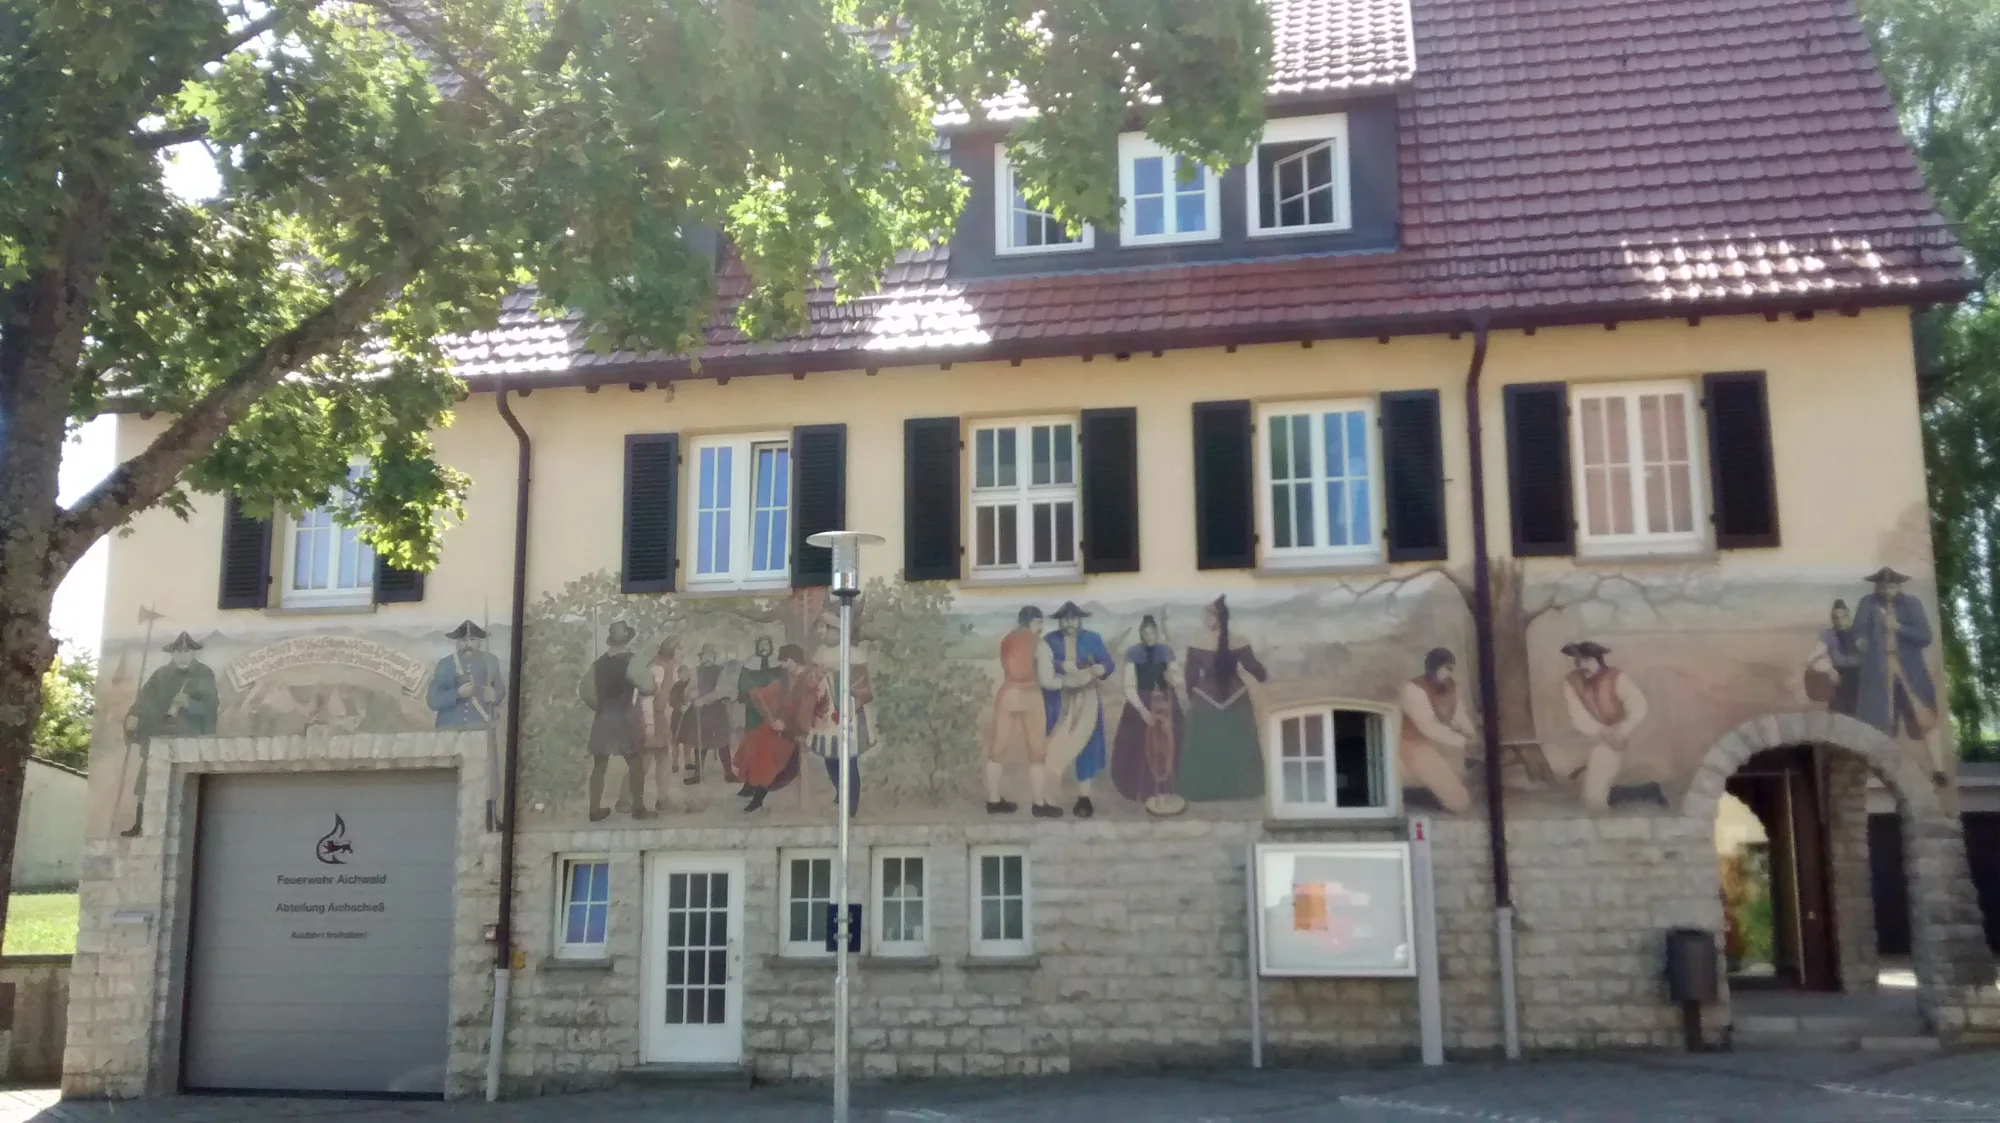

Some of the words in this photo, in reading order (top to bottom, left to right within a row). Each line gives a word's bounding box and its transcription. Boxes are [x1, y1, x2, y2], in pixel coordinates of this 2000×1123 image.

[277, 874, 334, 885] Feuerwehr
[336, 874, 387, 885] Aichwald
[275, 902, 326, 914] Abteilung
[327, 902, 386, 913] Aichschieß
